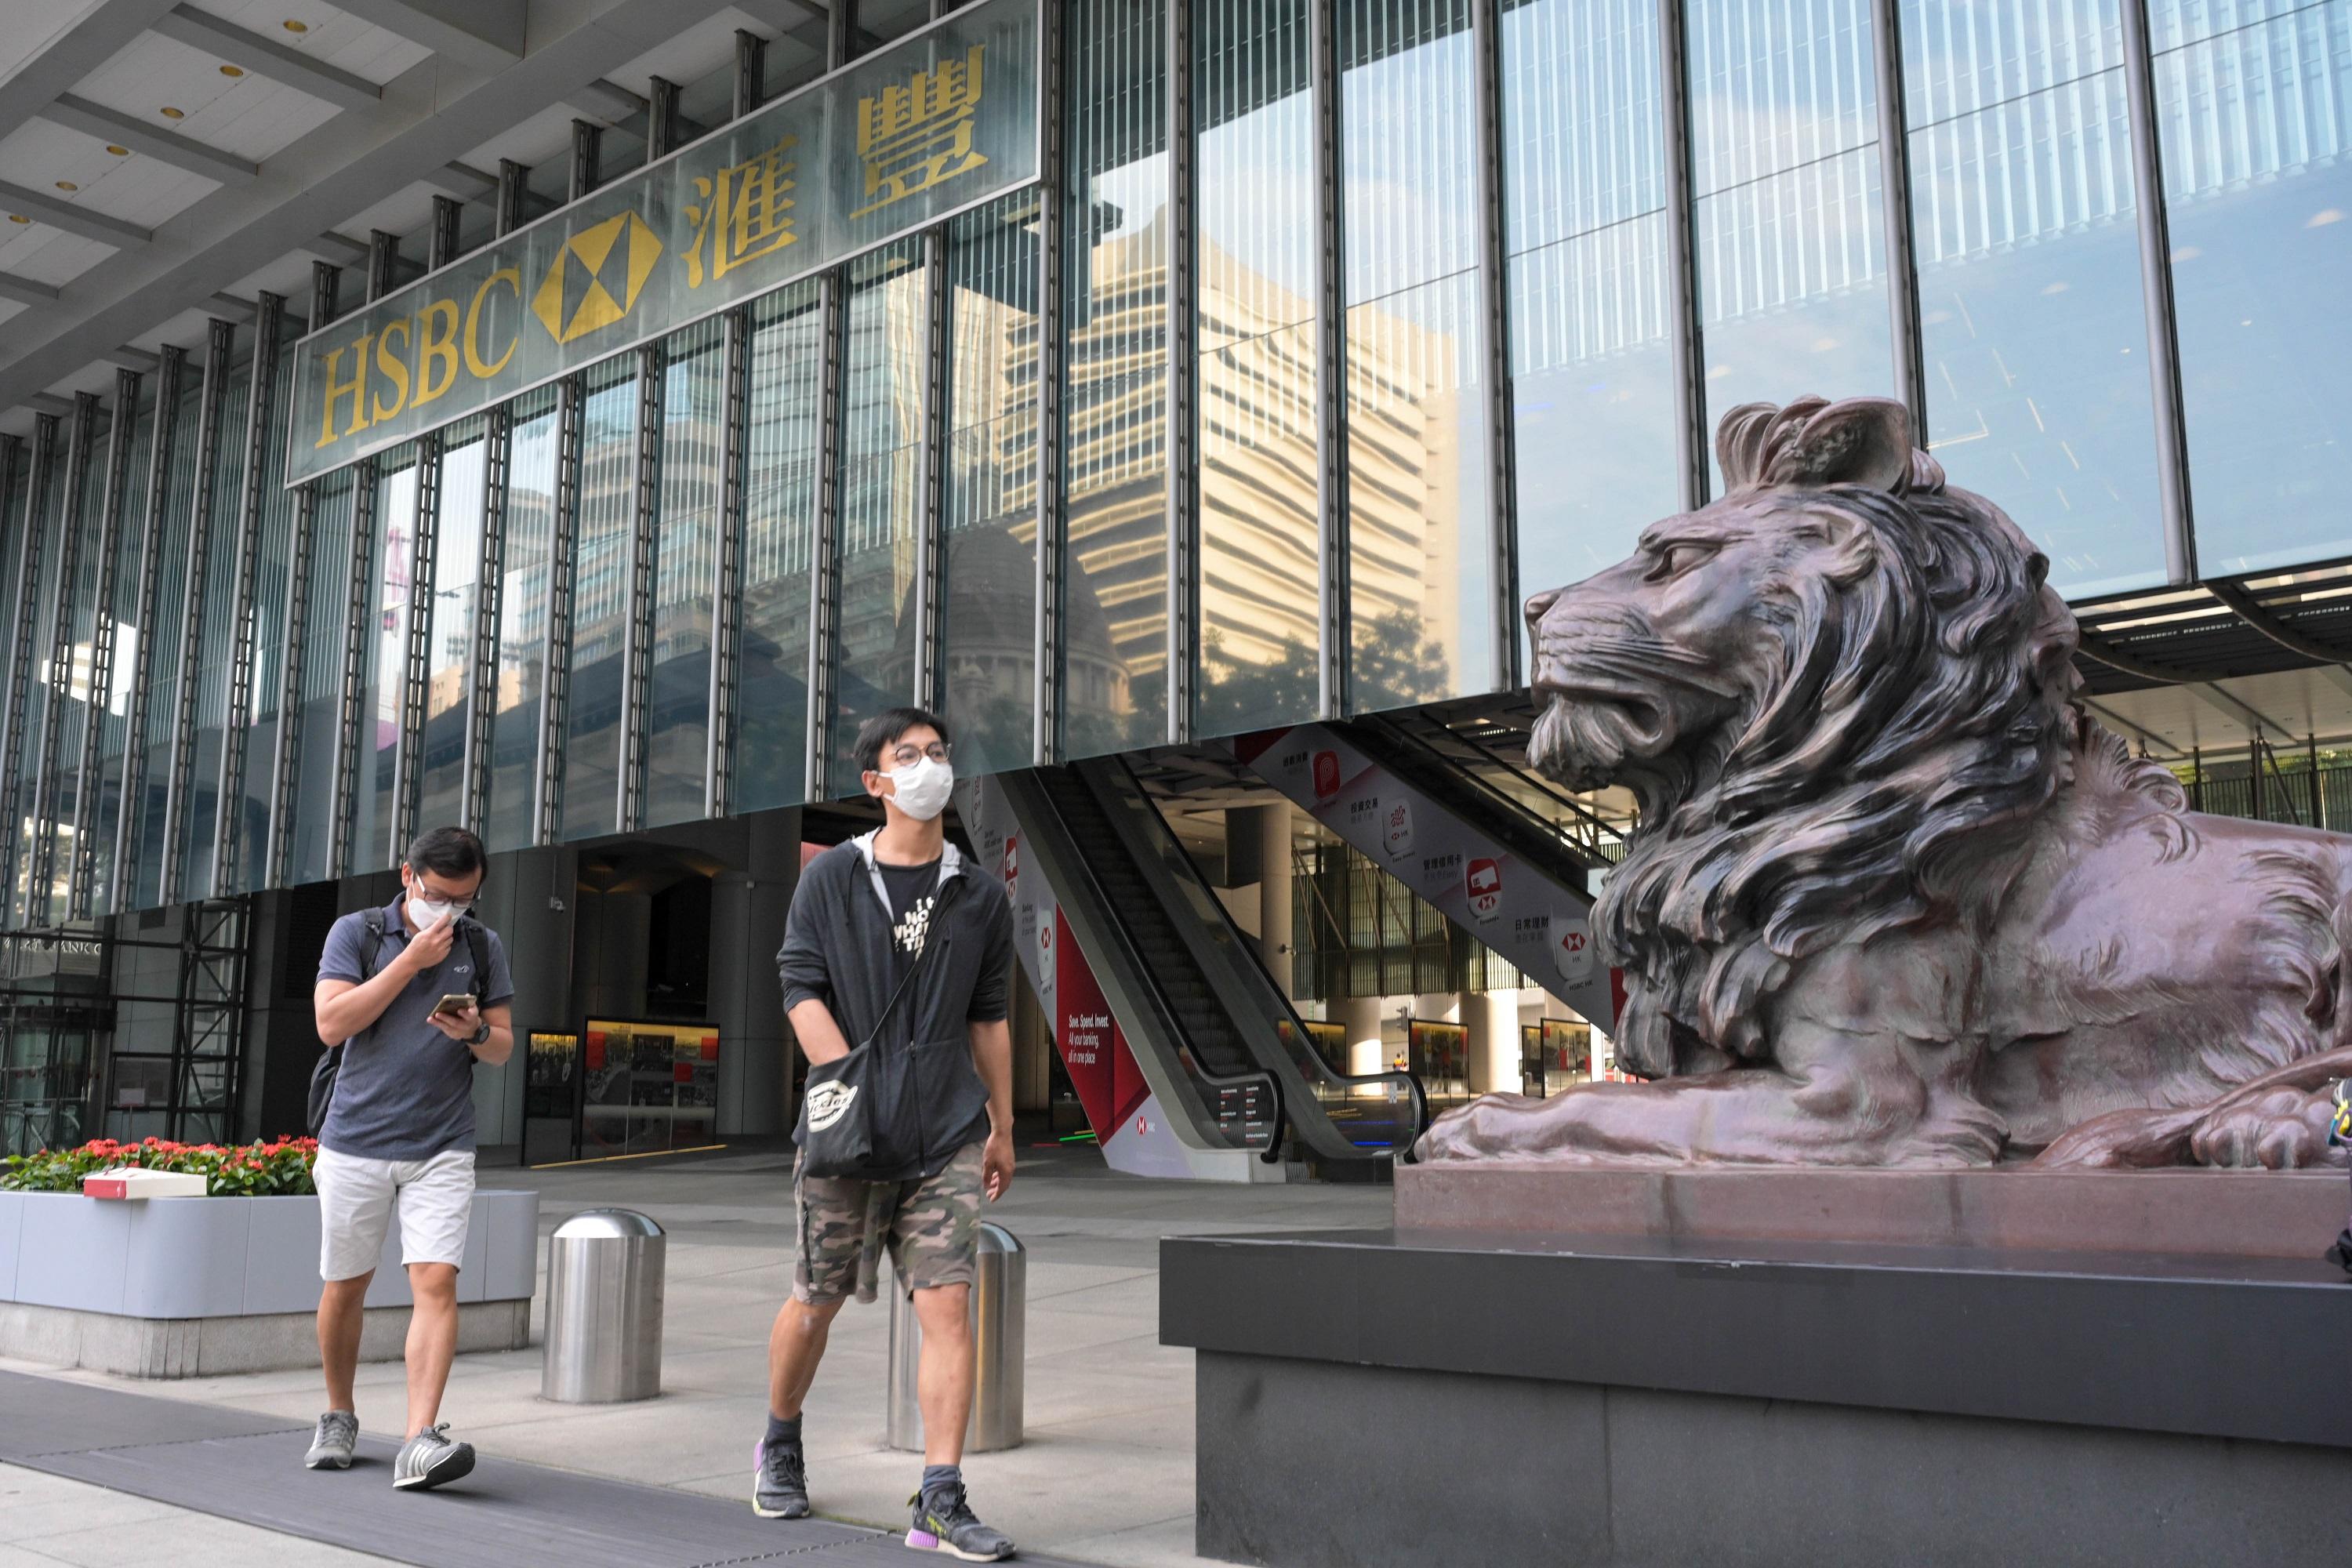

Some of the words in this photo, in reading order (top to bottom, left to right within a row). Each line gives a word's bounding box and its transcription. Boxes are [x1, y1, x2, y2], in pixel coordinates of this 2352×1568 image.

[315, 265, 521, 449] HSBC
[1069, 1014, 1080, 1029] Save.
[1080, 1013, 1094, 1031] Spend.
[1095, 1013, 1109, 1028] Invest.
[1085, 1050, 1095, 1066] place
